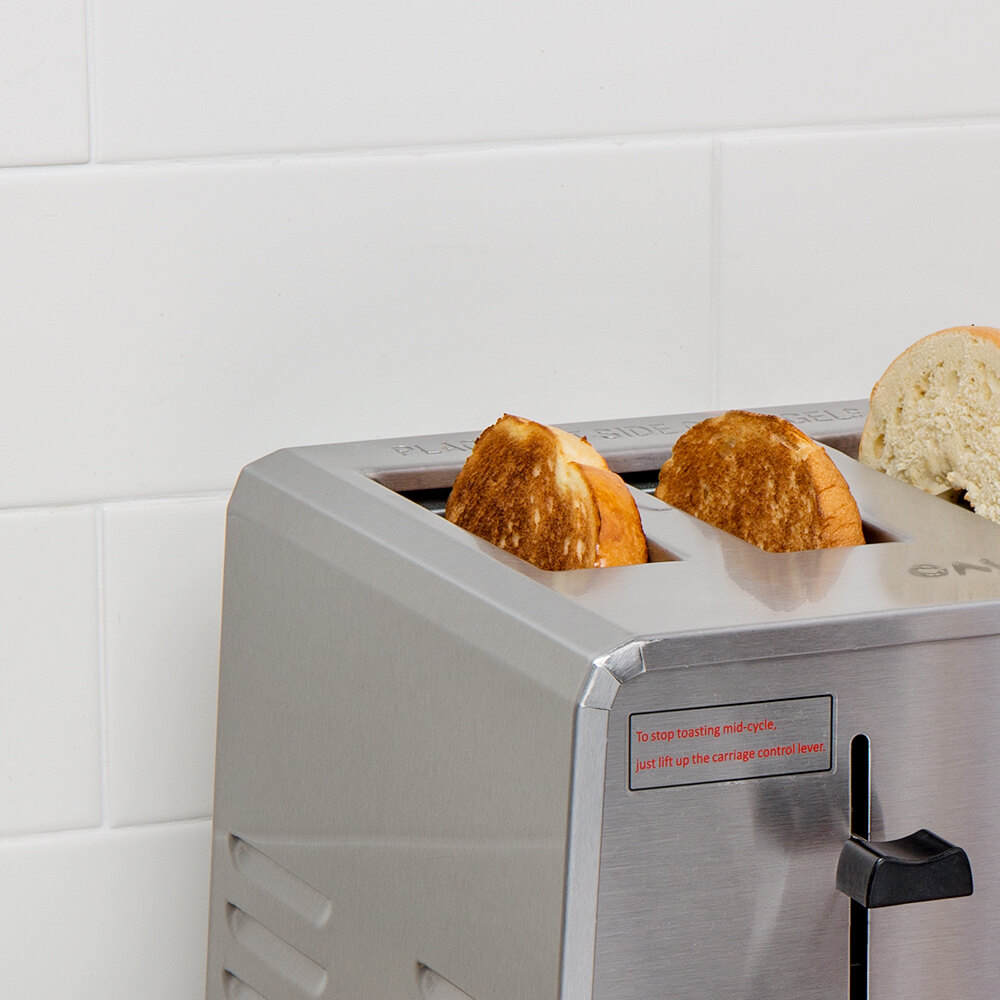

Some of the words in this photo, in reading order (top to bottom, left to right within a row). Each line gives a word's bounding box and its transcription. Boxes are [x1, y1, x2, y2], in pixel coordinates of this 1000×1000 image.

[593, 423, 679, 440] SIDE
[636, 731, 649, 743] To
[651, 729, 675, 743] stop
[677, 724, 721, 738] toasting
[723, 718, 777, 735] mid-cycle,
[635, 758, 656, 774] just
[659, 754, 673, 769] lift
[676, 756, 690, 769] up
[692, 752, 710, 765] the
[712, 749, 755, 763] carriage
[757, 742, 796, 758] control
[798, 741, 826, 755] lever.
